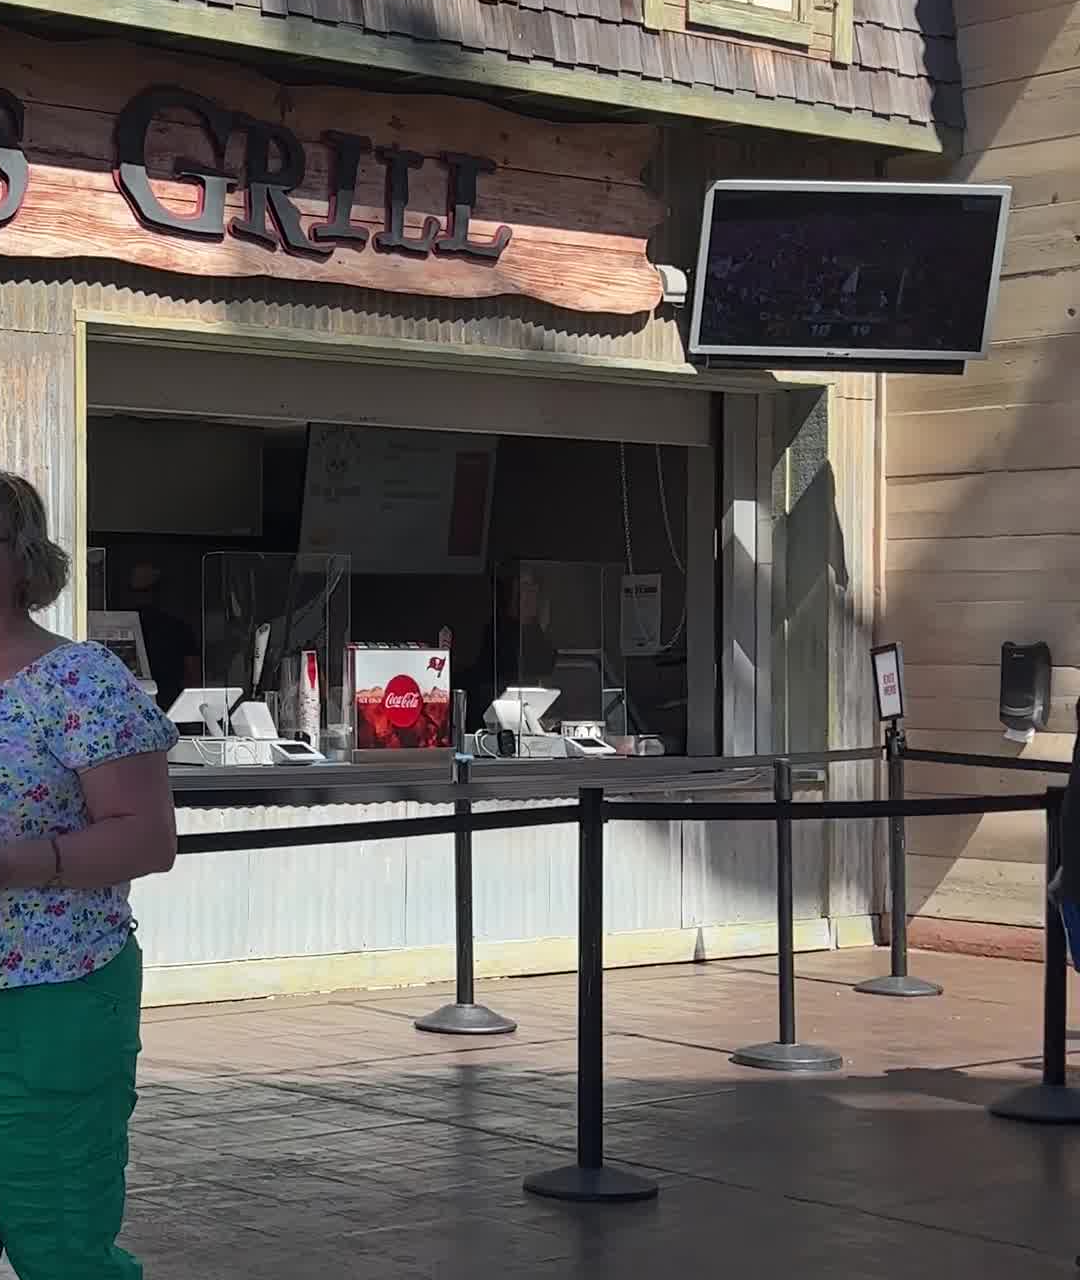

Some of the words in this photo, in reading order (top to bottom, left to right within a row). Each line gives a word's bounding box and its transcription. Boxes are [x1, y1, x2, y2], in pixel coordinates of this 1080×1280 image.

[113, 84, 512, 262] GRILL
[882, 672, 895, 685] EXIT
[384, 691, 421, 709] Coca-Cola
